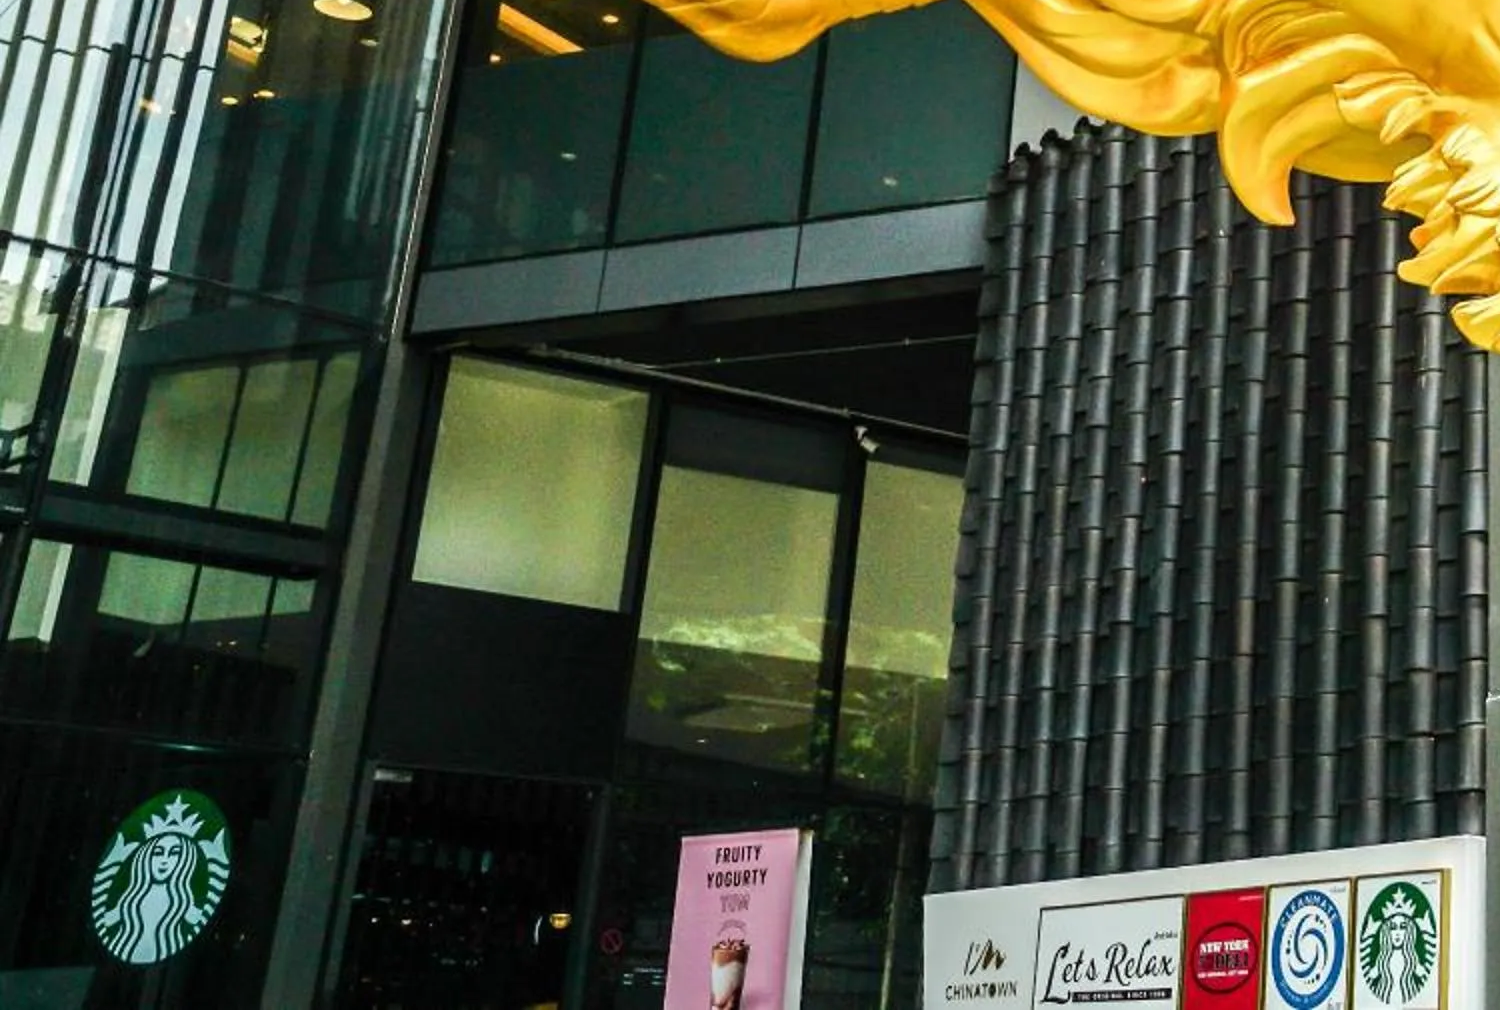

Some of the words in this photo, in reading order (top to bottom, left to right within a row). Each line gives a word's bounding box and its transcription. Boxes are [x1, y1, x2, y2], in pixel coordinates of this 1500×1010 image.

[715, 844, 763, 865] FRUITY
[706, 867, 768, 889] YOGURTY
[1103, 938, 1174, 987] Relax
[945, 981, 1018, 1001] CHINATOWN
